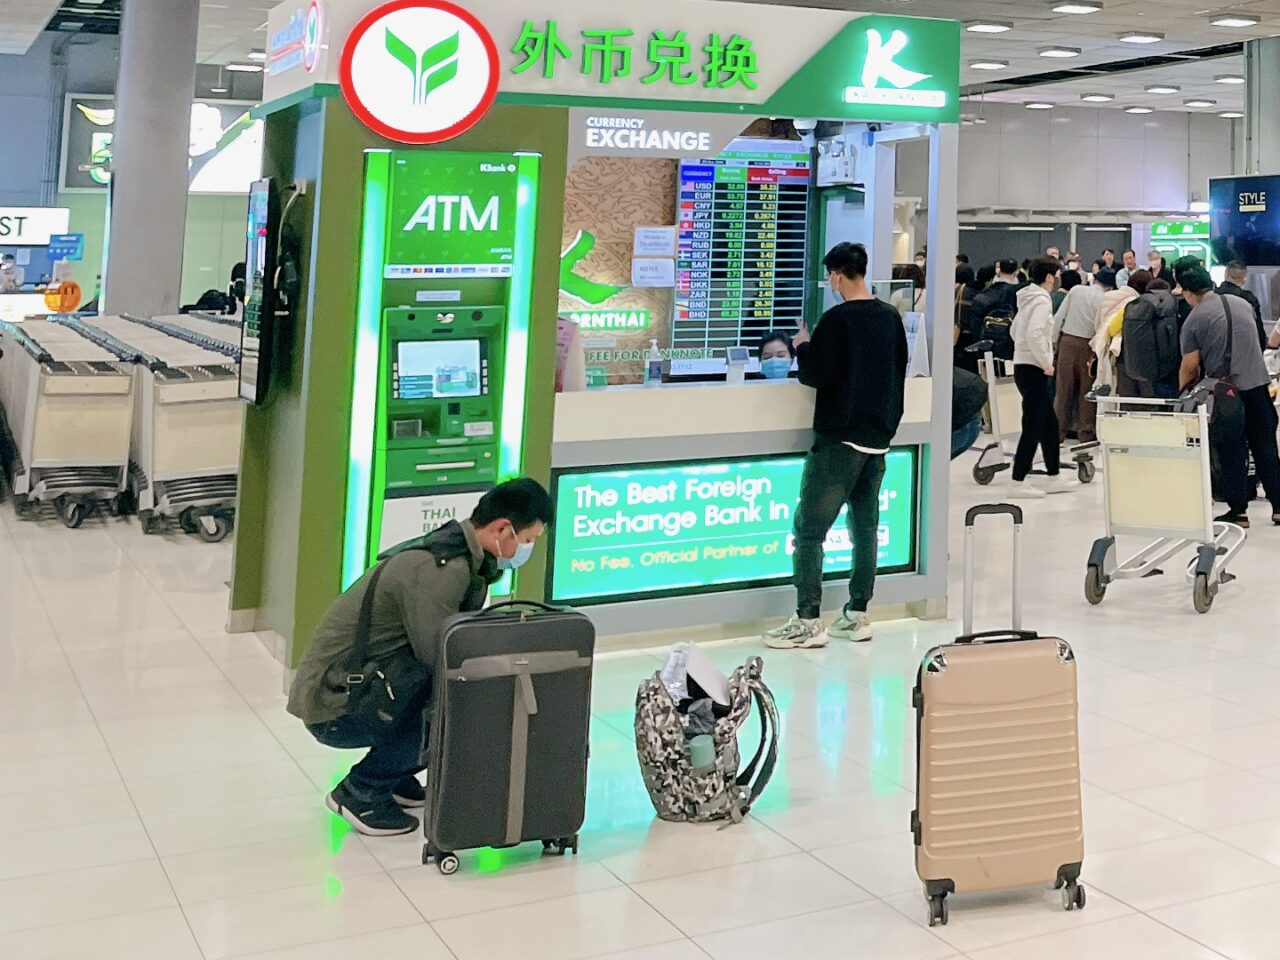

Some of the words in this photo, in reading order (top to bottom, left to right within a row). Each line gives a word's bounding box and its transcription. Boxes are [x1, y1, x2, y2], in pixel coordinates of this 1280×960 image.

[511, 19, 760, 91] 外币兑换
[586, 116, 645, 129] CURRENCY
[585, 128, 710, 151] EXCHANGE
[694, 192, 712, 200] EUR
[1239, 192, 1266, 205] STYLE
[402, 195, 500, 231] ATM
[692, 241, 709, 249] RUB
[570, 312, 645, 328] ORNTHAI
[614, 350, 640, 361] FOR
[573, 483, 618, 509] The
[627, 480, 677, 505] Best
[685, 475, 772, 503] Foreign
[422, 507, 456, 520] THAI
[573, 508, 697, 538] Exchange
[704, 500, 762, 527] Bank
[571, 558, 595, 573] No
[640, 548, 698, 567] Official
[703, 543, 758, 560] Partner
[763, 540, 779, 554] of
